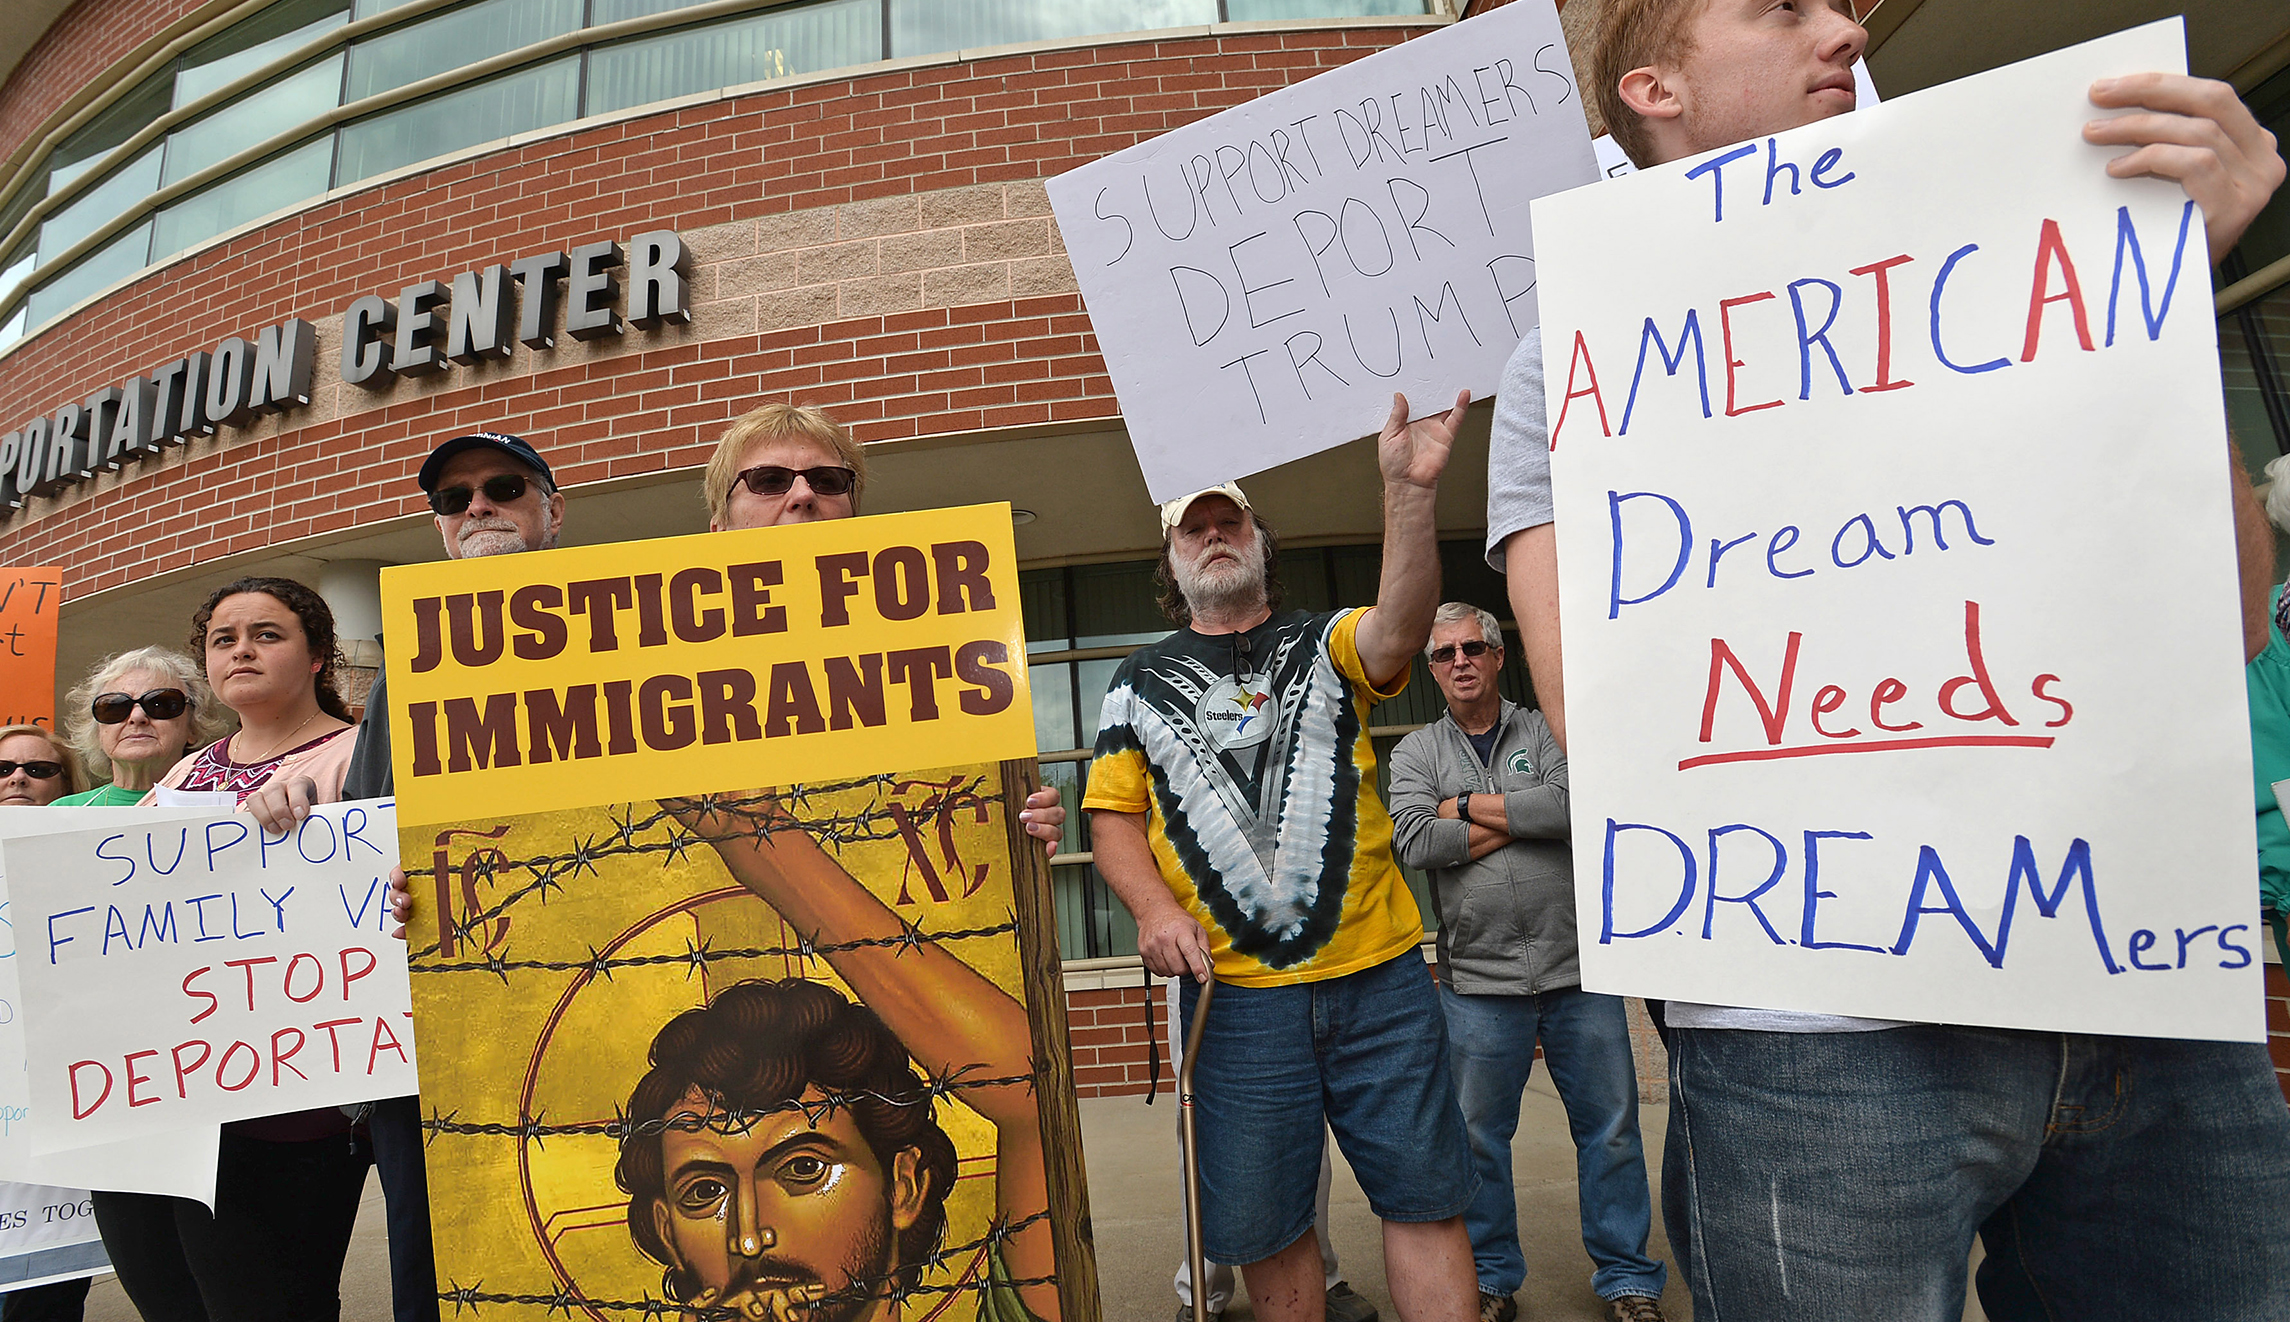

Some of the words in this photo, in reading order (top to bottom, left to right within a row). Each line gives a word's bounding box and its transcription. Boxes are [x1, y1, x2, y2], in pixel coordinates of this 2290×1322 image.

[1095, 115, 1322, 267] SUPPORT
[1333, 43, 1572, 171] DREAMERS
[1685, 138, 1855, 222] The
[1168, 136, 1509, 347] DEPORT
[340, 229, 691, 391] CENTER
[1220, 255, 1537, 424] TRUMP
[1550, 201, 2194, 452] AMERICAN
[410, 559, 788, 674] JUSTICE
[814, 540, 997, 628] FOR
[1608, 489, 1995, 619] Dream
[408, 640, 1014, 778] IMMIGRANTS
[1206, 709, 1244, 721] Steelers
[1698, 601, 2073, 746] Needs
[47, 886, 294, 964] FAMILY
[182, 947, 376, 1024] STOP
[68, 1012, 412, 1120] DEPORTA
